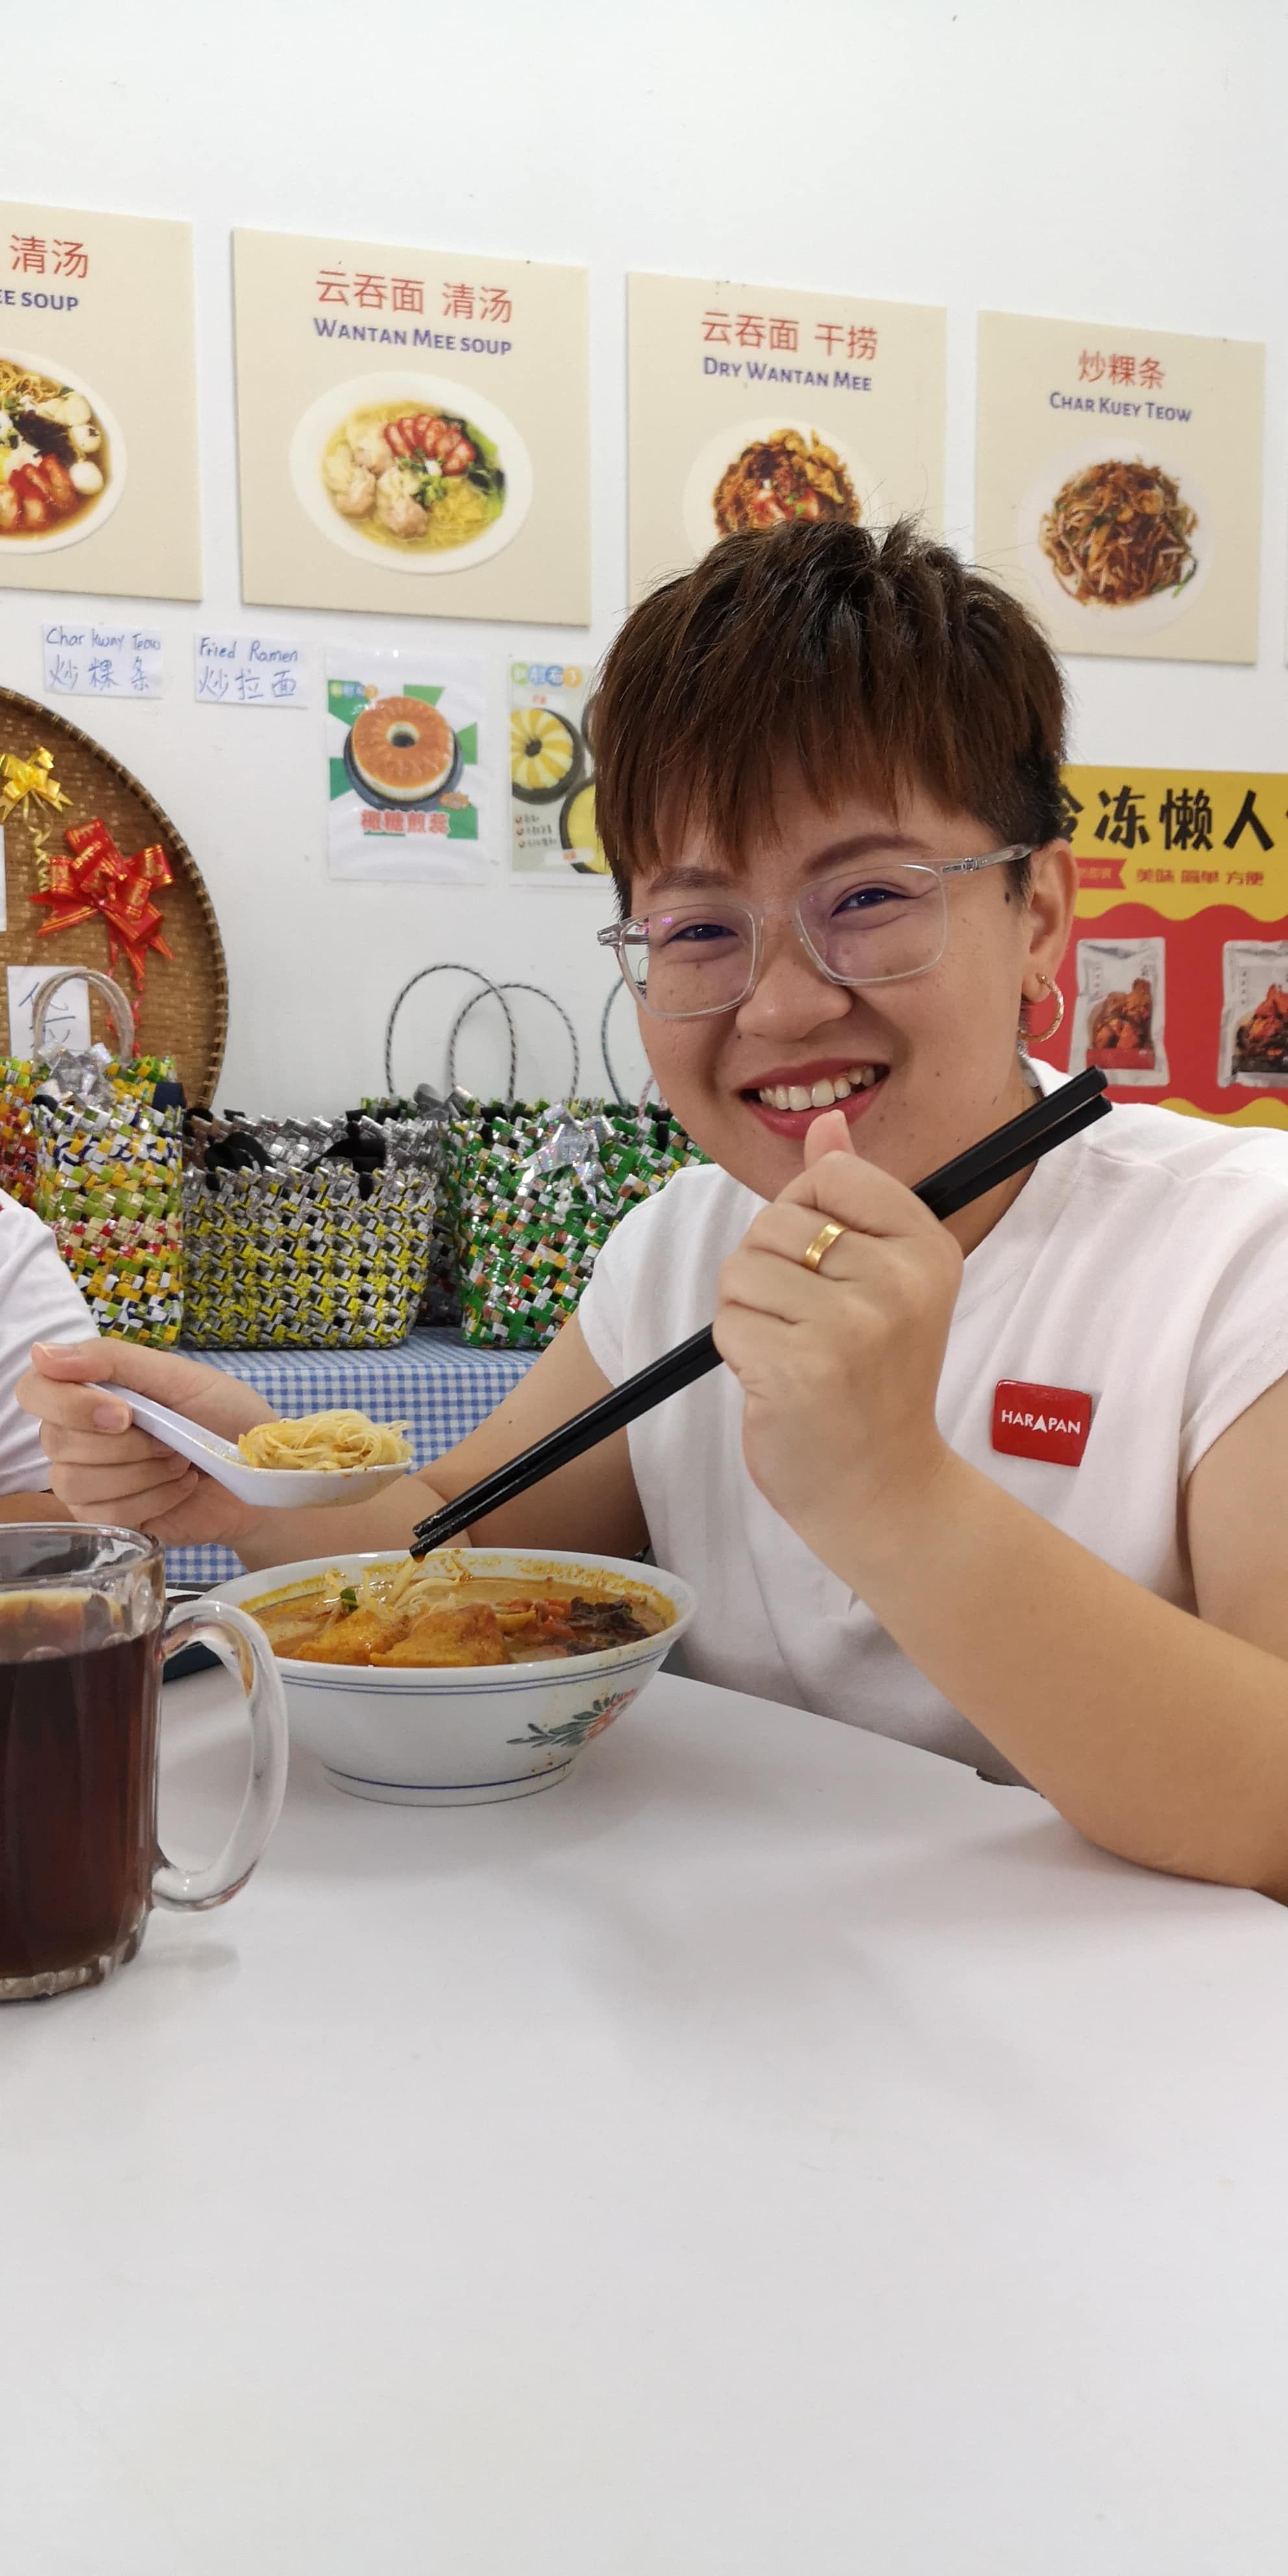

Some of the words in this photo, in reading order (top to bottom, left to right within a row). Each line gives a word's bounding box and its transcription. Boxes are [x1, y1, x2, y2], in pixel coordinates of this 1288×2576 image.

[10, 234, 90, 279] 清汤
[21, 291, 79, 312] SOUP
[316, 269, 425, 315] 云吞面
[442, 282, 513, 324] 清汤
[460, 336, 512, 356] SOUP
[701, 311, 799, 353] 云吞面
[814, 323, 878, 361] 干捞
[1078, 349, 1166, 390] 炒粿条
[46, 626, 85, 647] Char
[199, 637, 237, 659] Fried
[249, 639, 299, 663] Ramen
[1059, 784, 1288, 852] 冻懒人
[1000, 1409, 1082, 1435] HARAPAN
